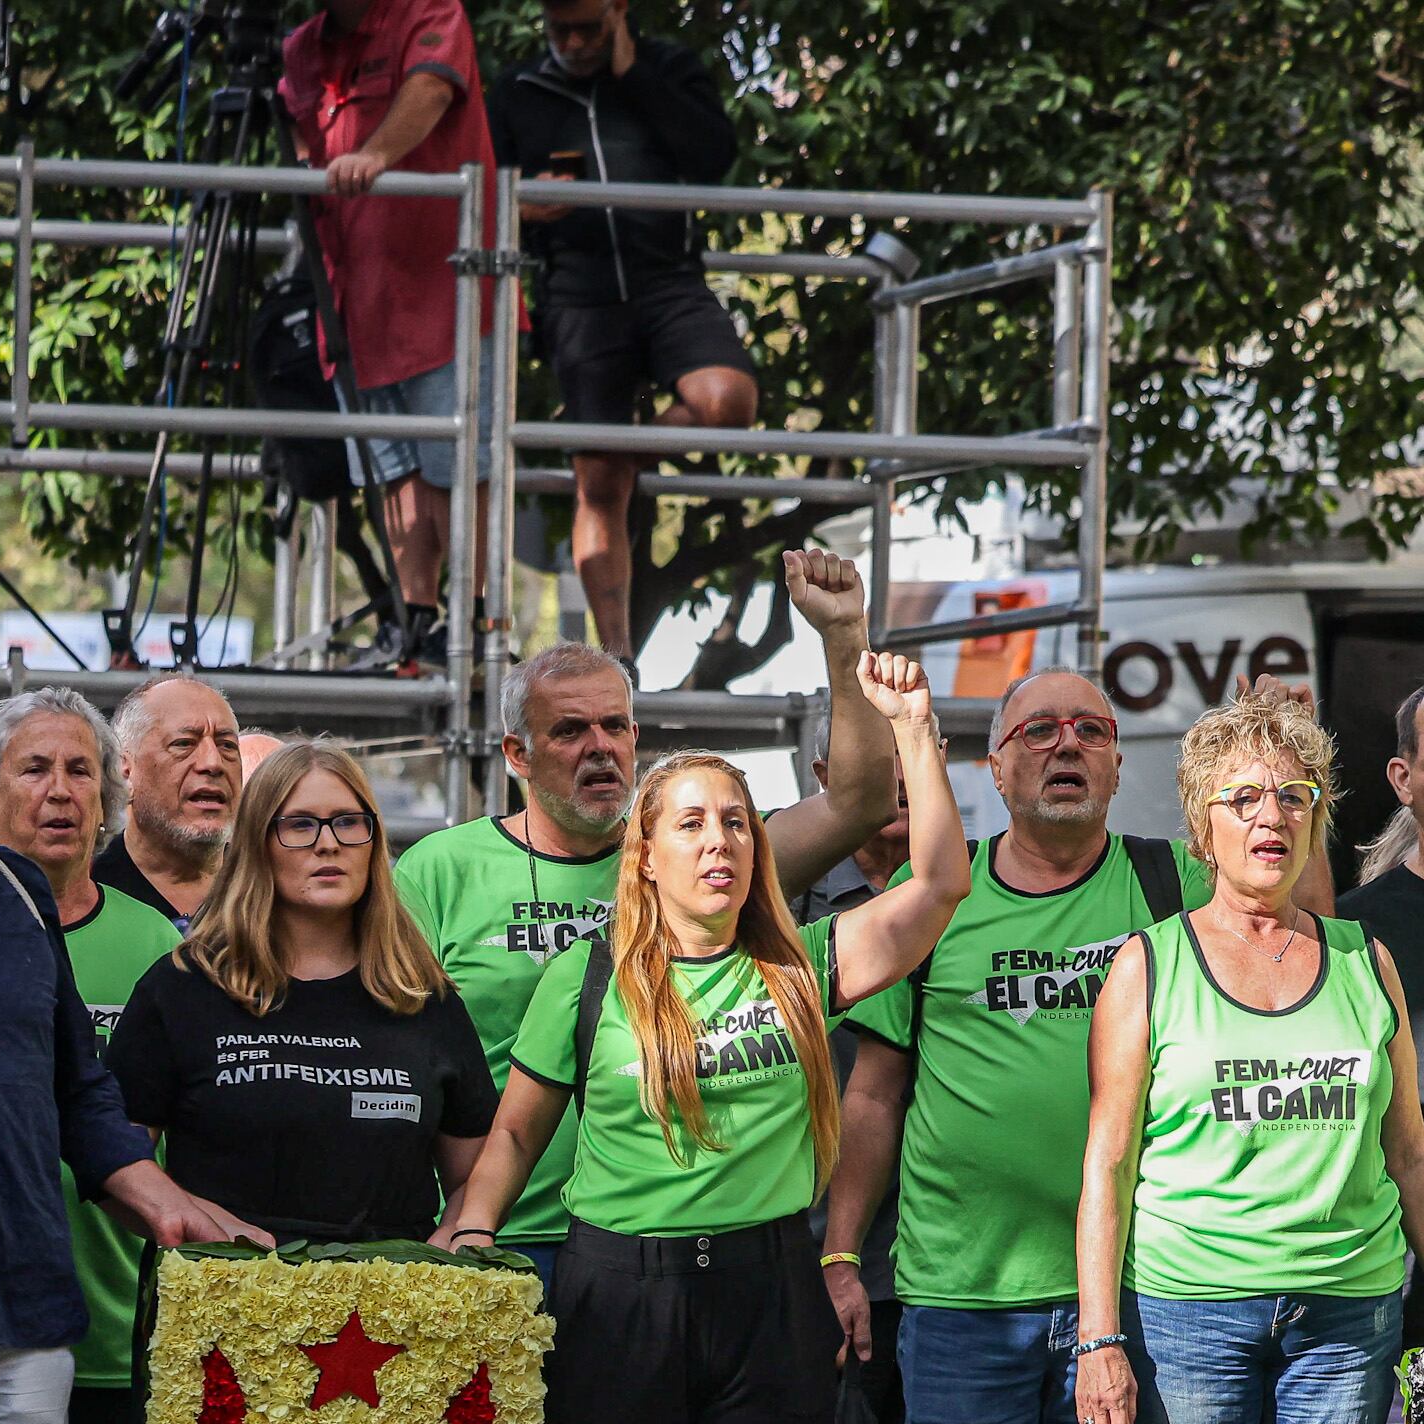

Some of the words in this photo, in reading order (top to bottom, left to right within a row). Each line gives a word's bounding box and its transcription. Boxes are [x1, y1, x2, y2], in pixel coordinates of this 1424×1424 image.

[507, 924, 548, 952] EL
[991, 949, 1054, 972] FEM
[985, 975, 1028, 1011] EL
[215, 1034, 279, 1049] PARLAR
[279, 1034, 362, 1049] VALENCIÀ
[239, 1049, 270, 1062] FER
[215, 1063, 413, 1088] ANTIFEIXISME
[699, 1066, 801, 1090] NDEPENDÈNCIA
[1214, 1058, 1279, 1083] FEM
[359, 1100, 417, 1113] Decidim
[1210, 1086, 1252, 1122] EL
[1257, 1082, 1358, 1121] CAMÍ
